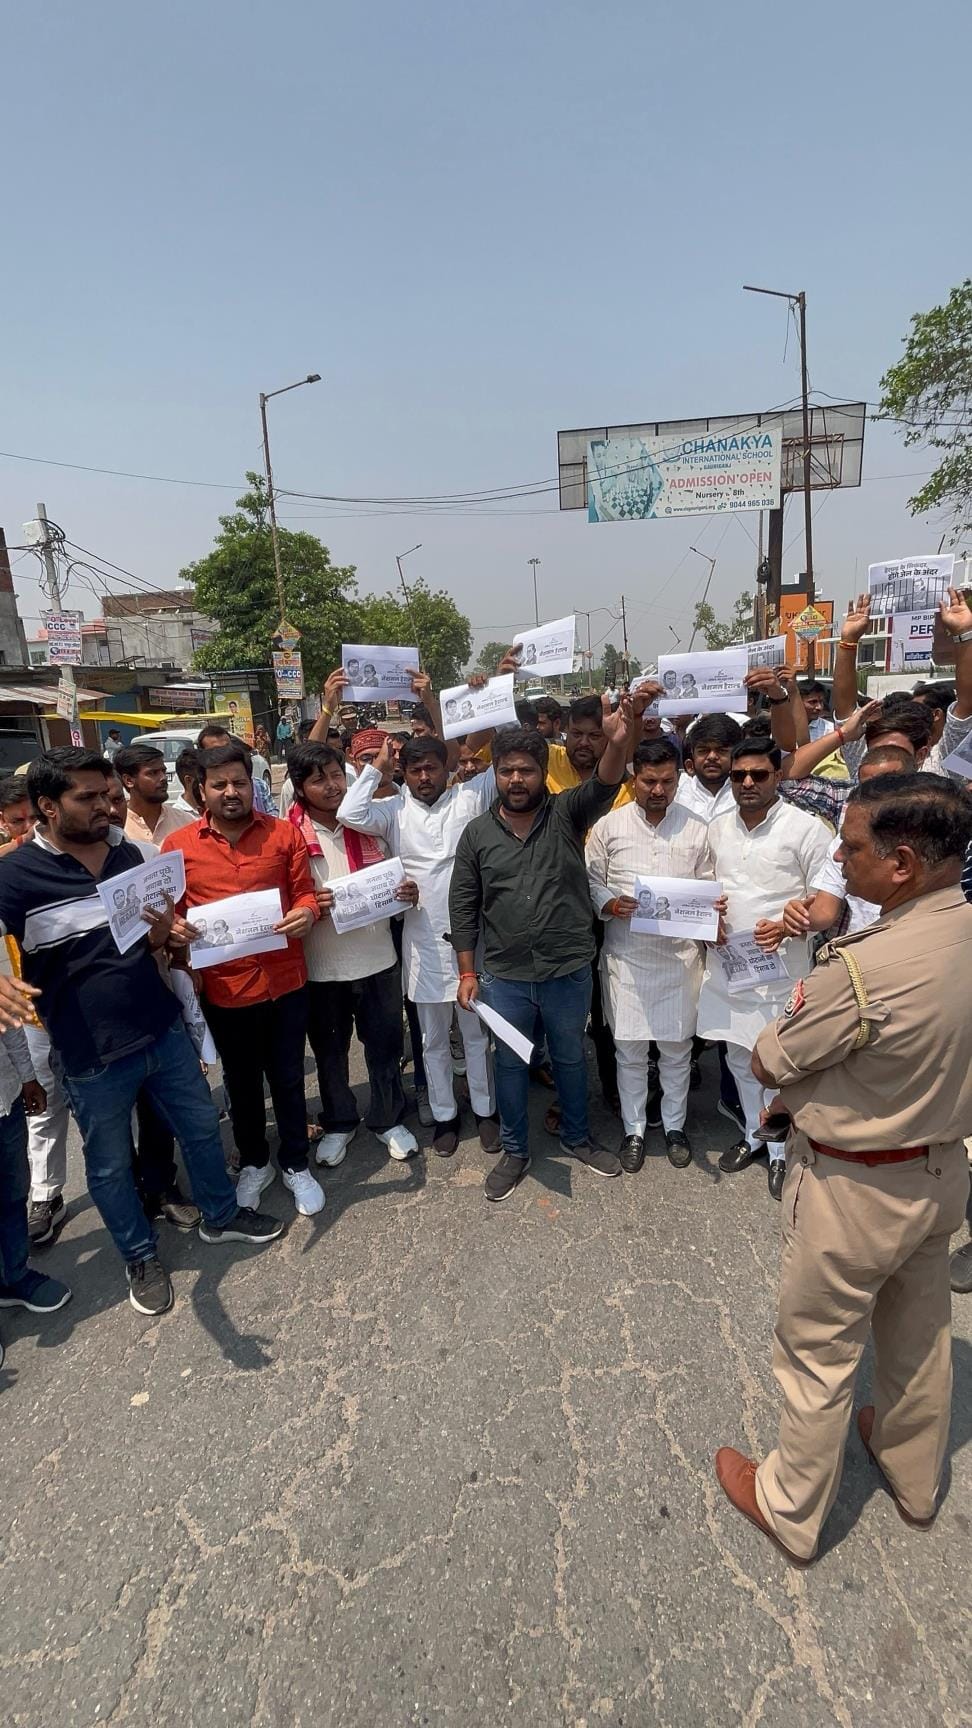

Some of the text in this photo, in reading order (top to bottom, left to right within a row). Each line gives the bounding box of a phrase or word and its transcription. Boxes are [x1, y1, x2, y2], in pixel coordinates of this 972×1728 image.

[682, 434, 773, 454] CHANAKYA
[682, 450, 774, 464] INTERNATIONAL SCHOOL
[669, 471, 772, 489] ADMISSION OPEN
[695, 490, 724, 499] Nursery
[732, 488, 745, 496] 8th
[913, 568, 922, 576] के
[923, 568, 939, 576] अंदर
[287, 669, 301, 678] CCC
[723, 681, 741, 690] हेराल्ड
[163, 876, 172, 885] दो
[388, 878, 396, 886] दो
[369, 889, 392, 901] घोटालों
[374, 897, 394, 909] हिसाब
[675, 908, 696, 916] नेशनल
[753, 965, 770, 973] हिसाब
